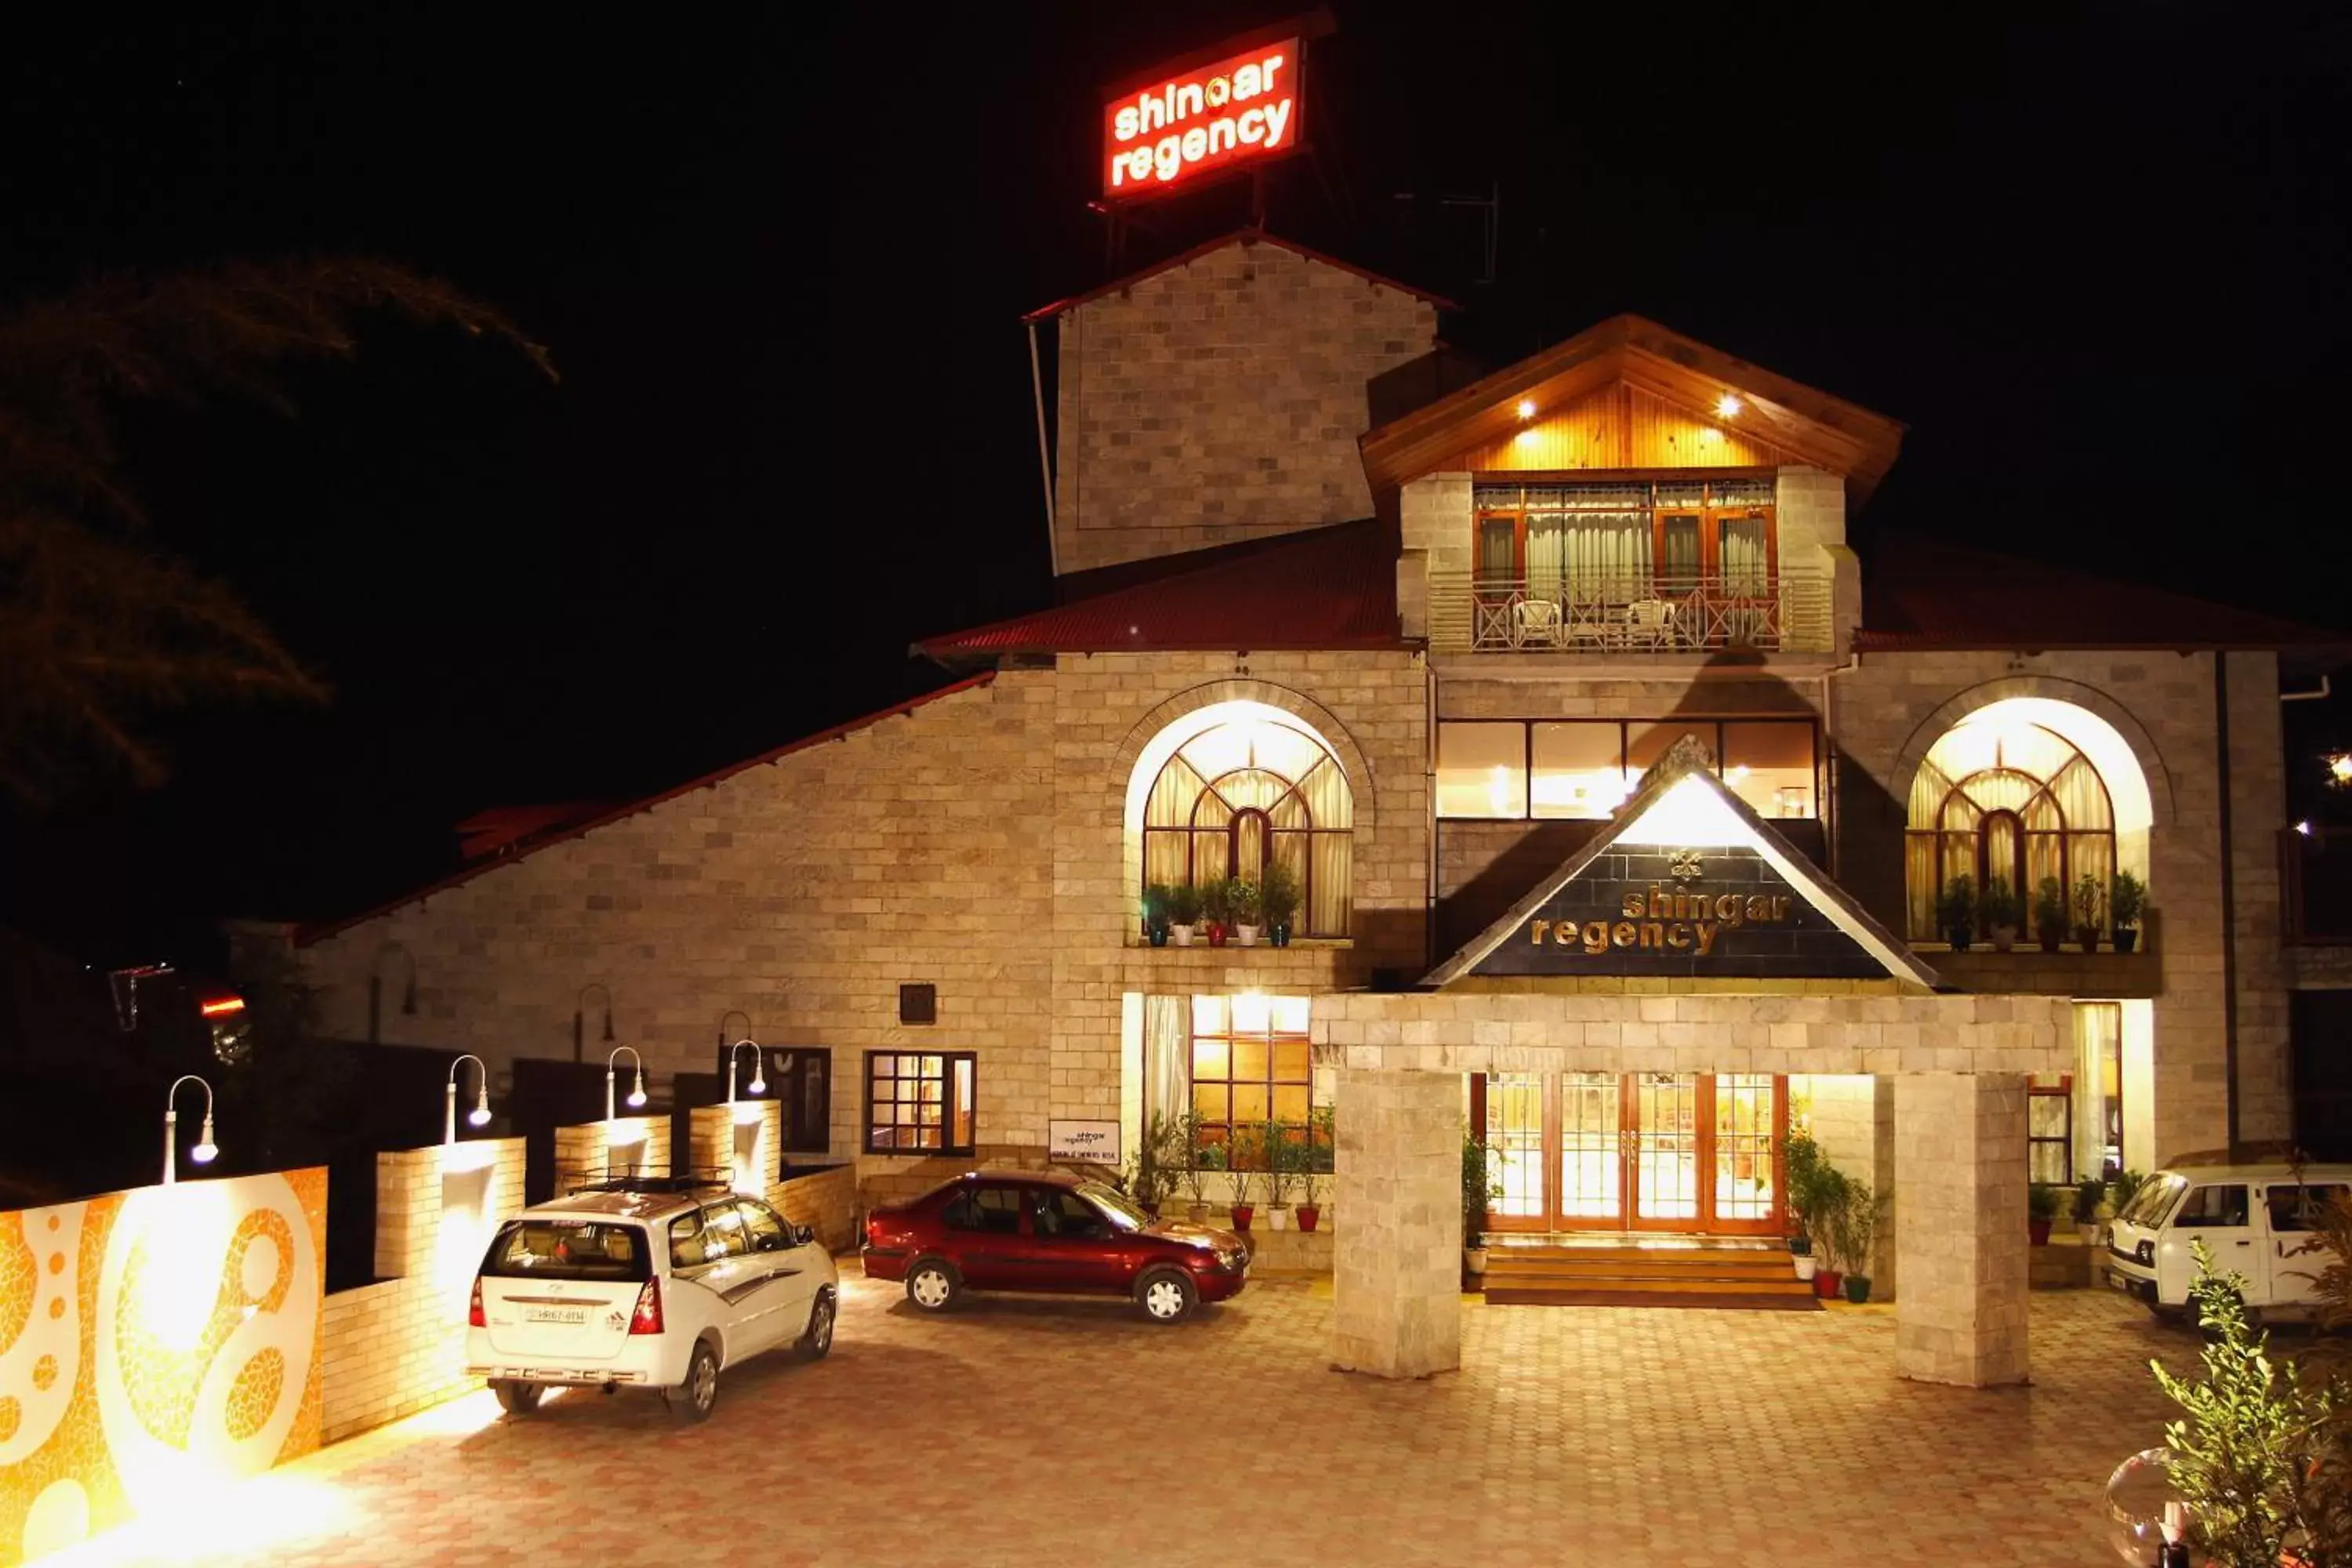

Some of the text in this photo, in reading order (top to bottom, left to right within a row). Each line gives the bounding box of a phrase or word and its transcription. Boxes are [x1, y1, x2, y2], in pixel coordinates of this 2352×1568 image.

[1112, 98, 1291, 186] regency
[1621, 885, 1791, 927] shingar
[1530, 919, 1718, 956] regency
